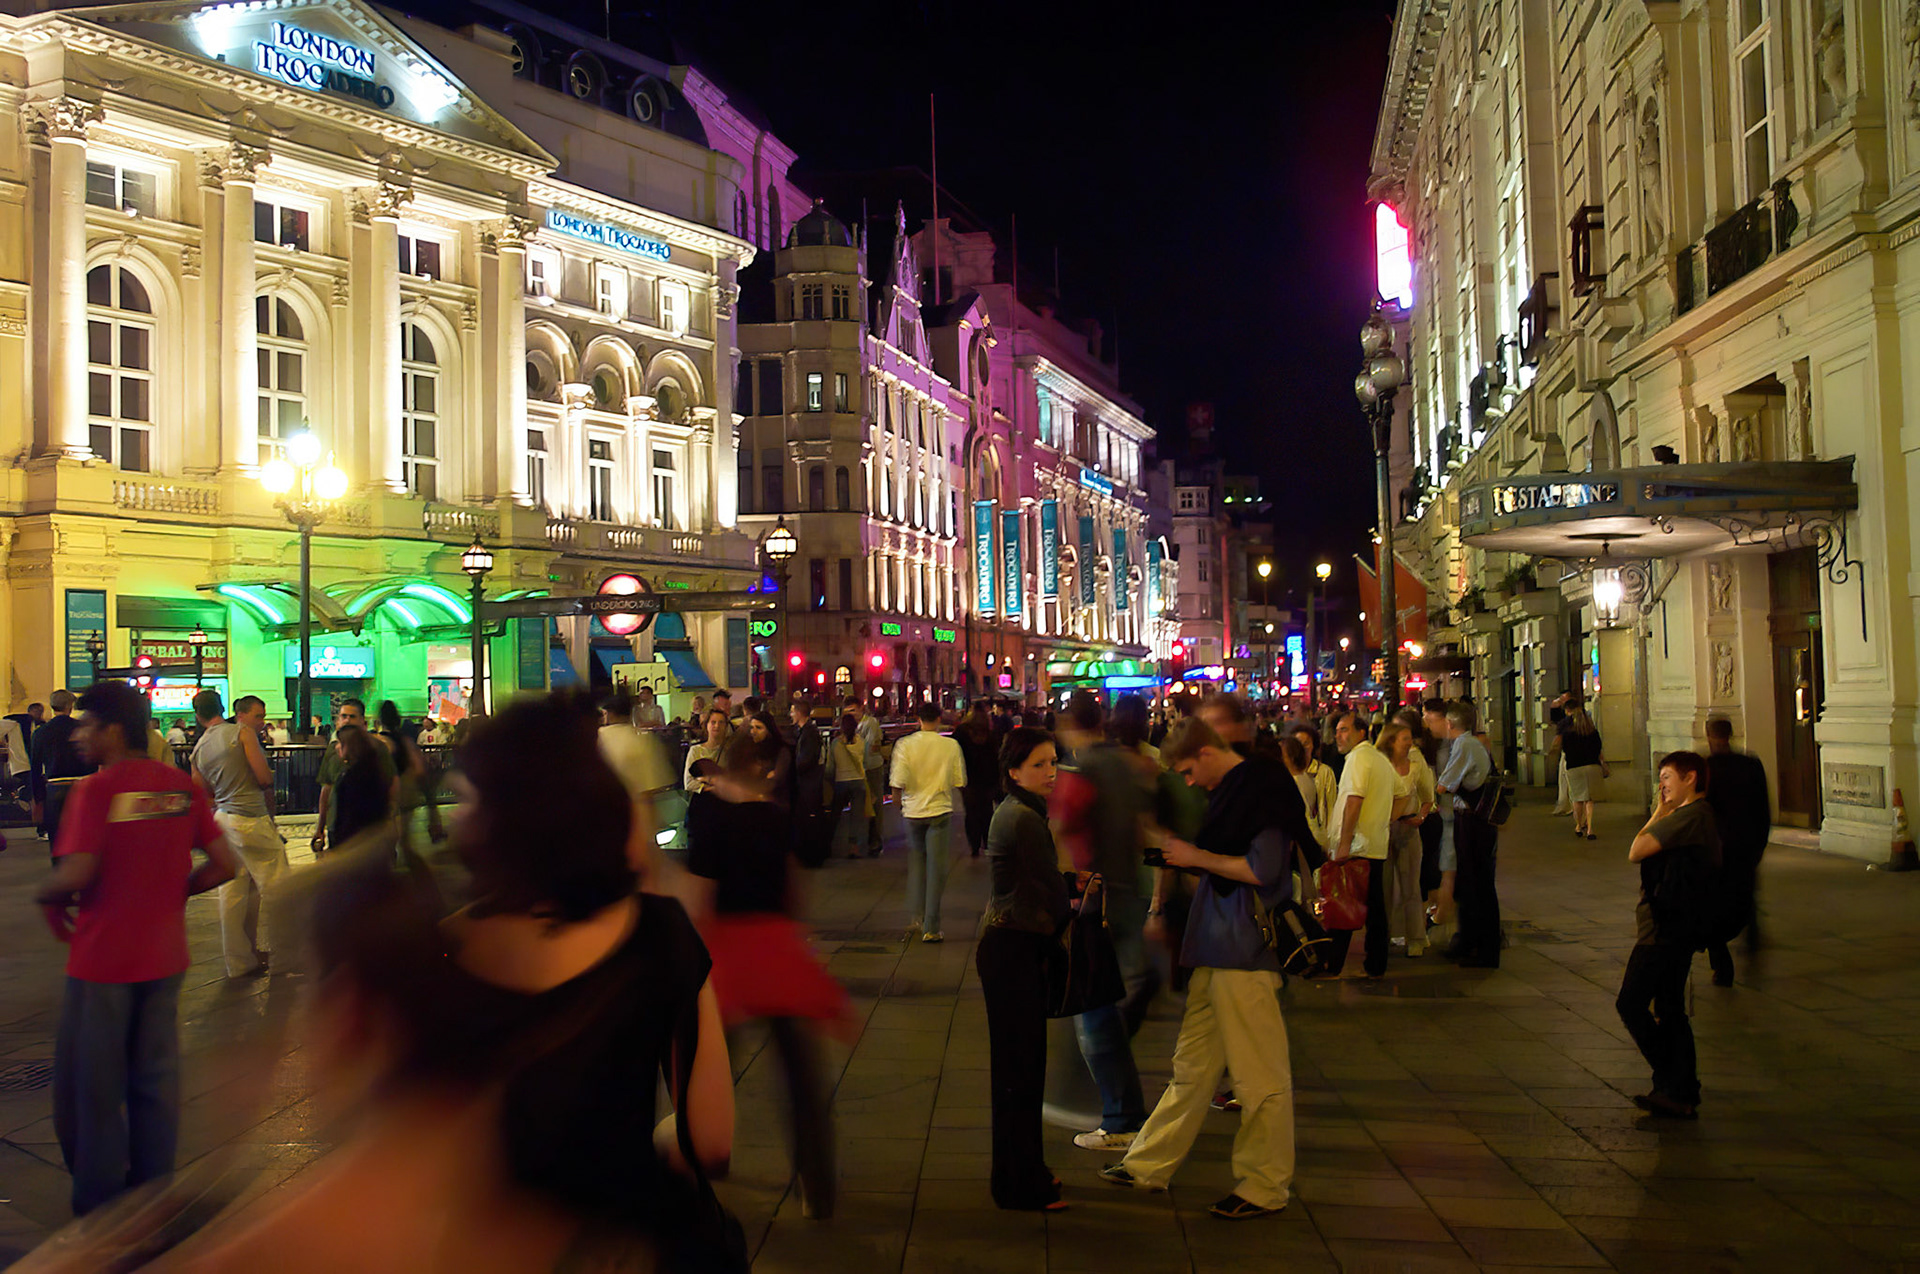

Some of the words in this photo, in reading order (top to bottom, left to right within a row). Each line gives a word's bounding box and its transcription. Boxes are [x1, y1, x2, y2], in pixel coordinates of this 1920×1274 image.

[272, 21, 375, 77] LONDON
[548, 210, 604, 243] LONDON
[1493, 484, 1619, 516] RESTAURANT
[978, 531, 991, 604] TROCADERO
[1006, 539, 1018, 608] TROCADERO
[1044, 528, 1056, 590] TROCADERO
